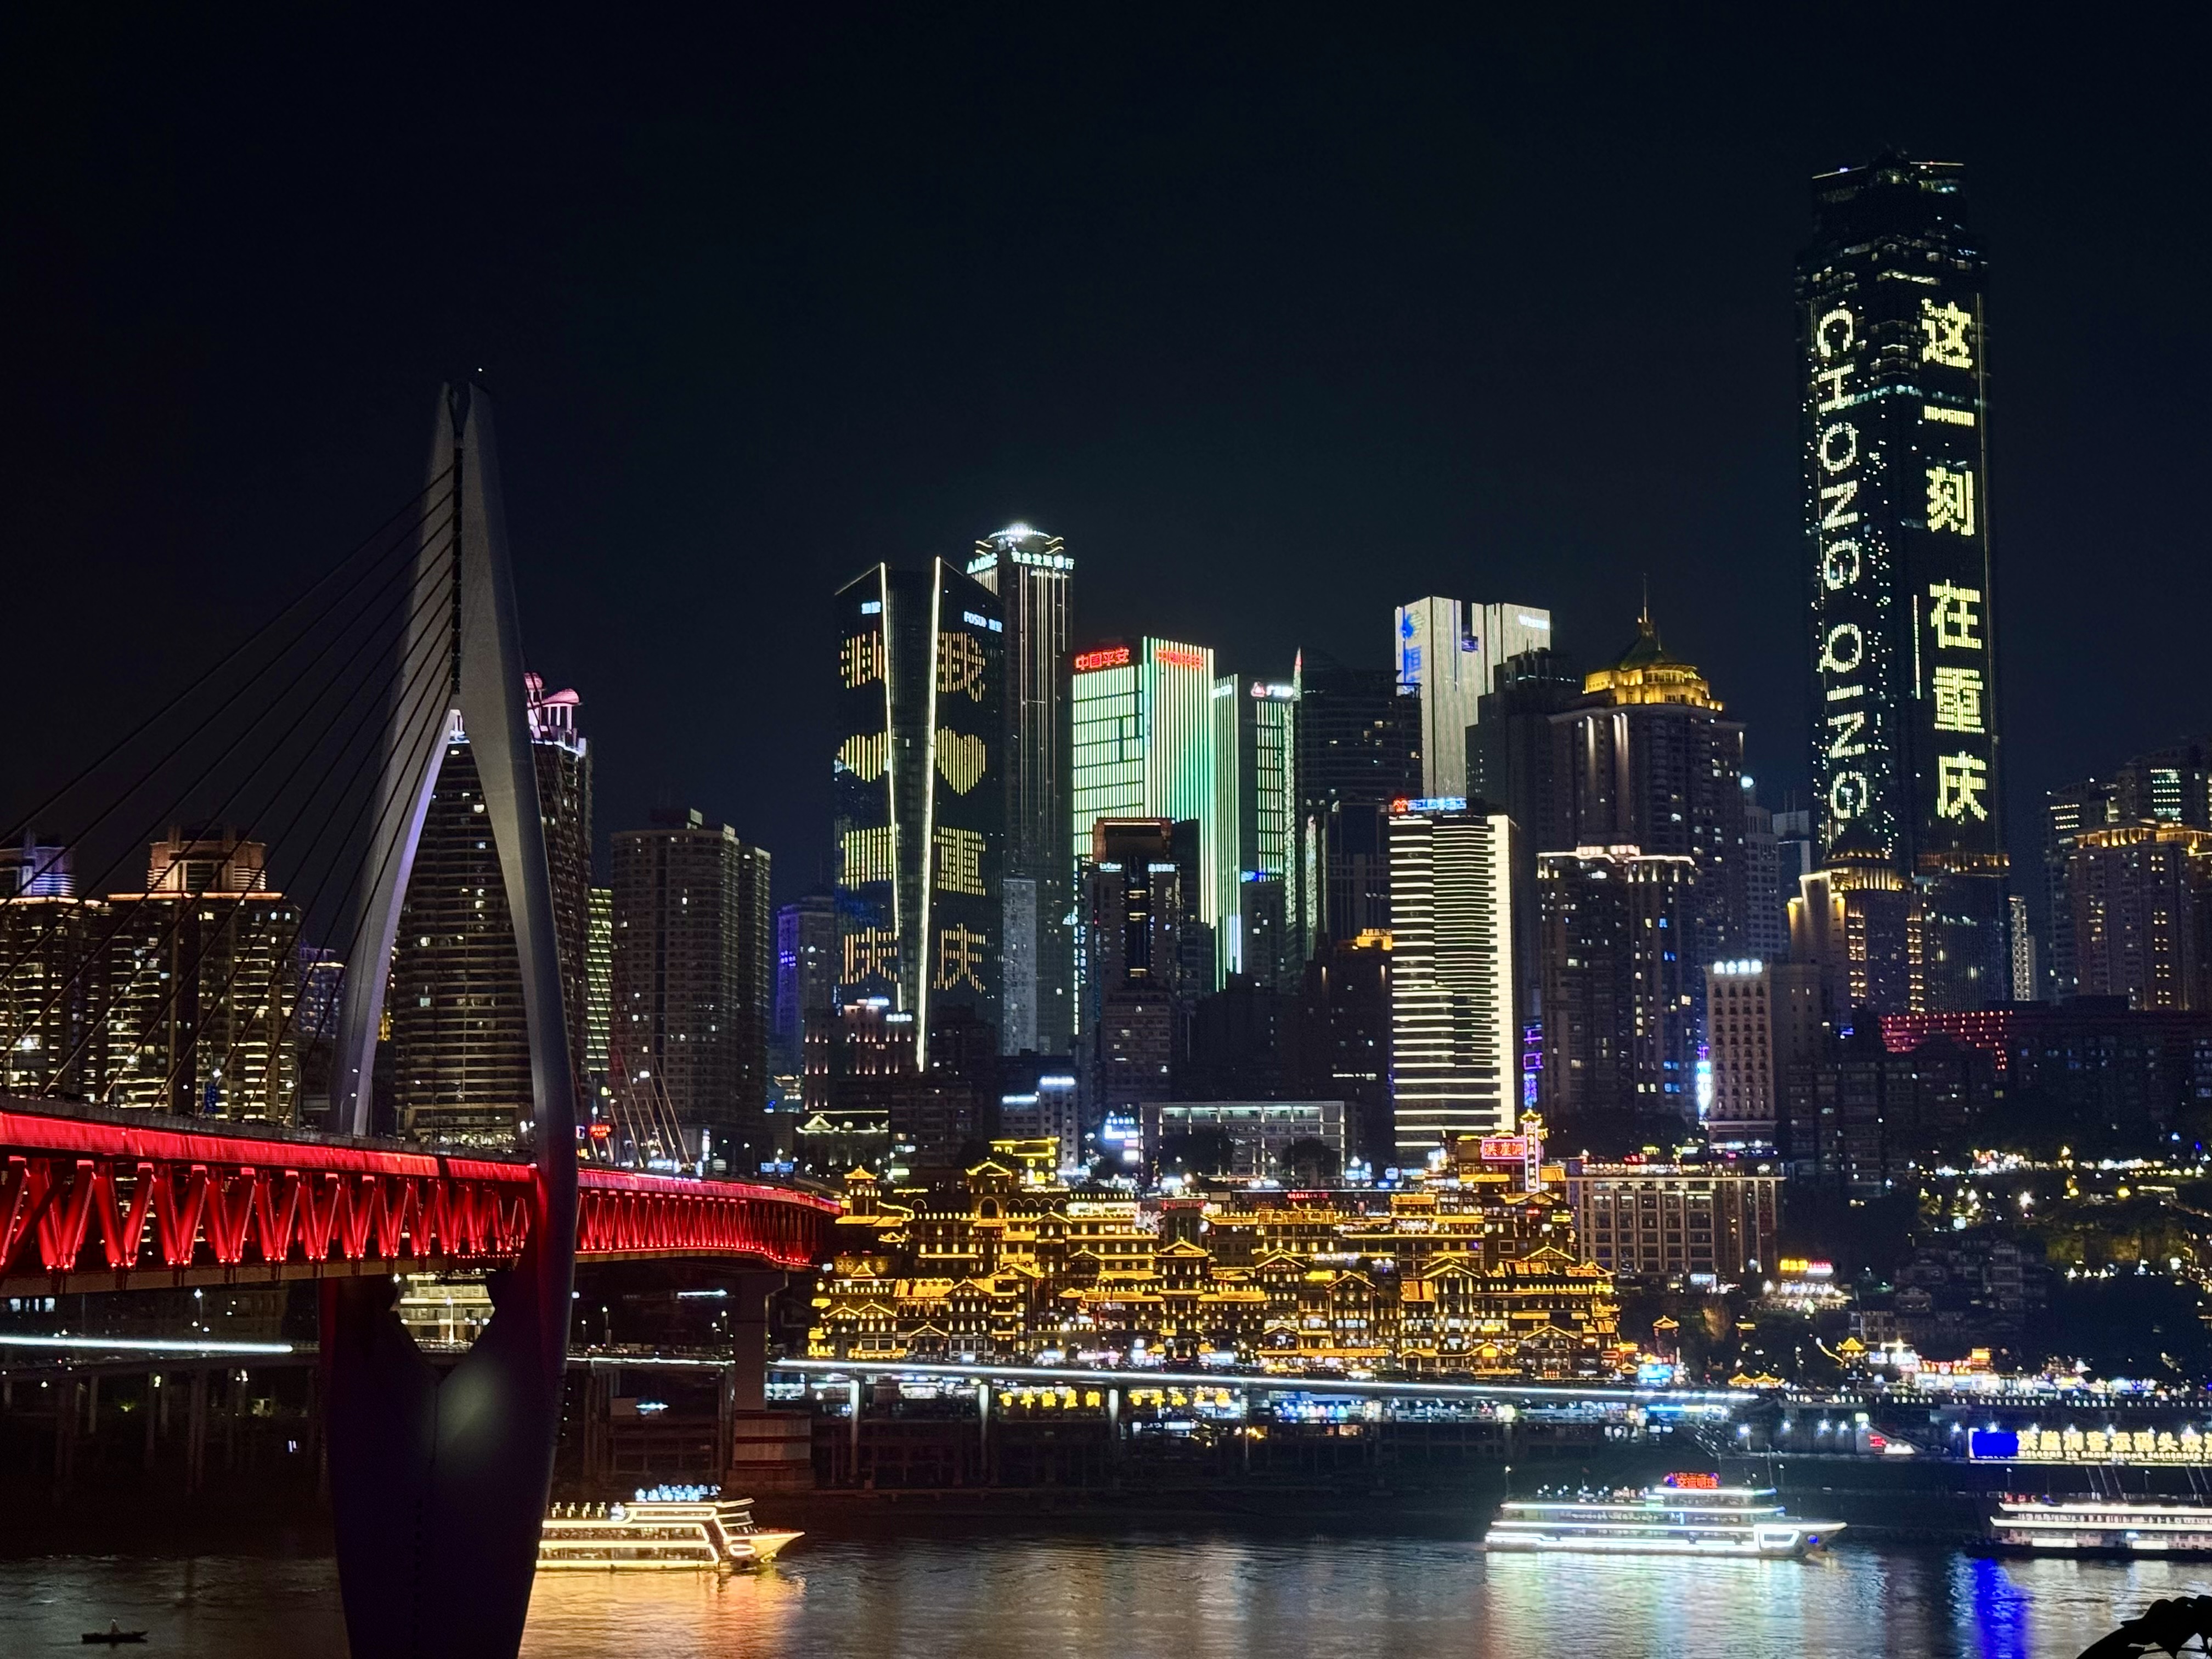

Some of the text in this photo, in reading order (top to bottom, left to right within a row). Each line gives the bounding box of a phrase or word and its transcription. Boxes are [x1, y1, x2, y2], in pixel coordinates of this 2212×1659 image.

[1922, 297, 1988, 820] 这一刻在重庆
[1076, 647, 1130, 670] 中国平安
[1156, 649, 1204, 670] 中国平安
[1485, 1142, 1524, 1157] 洪崖洞
